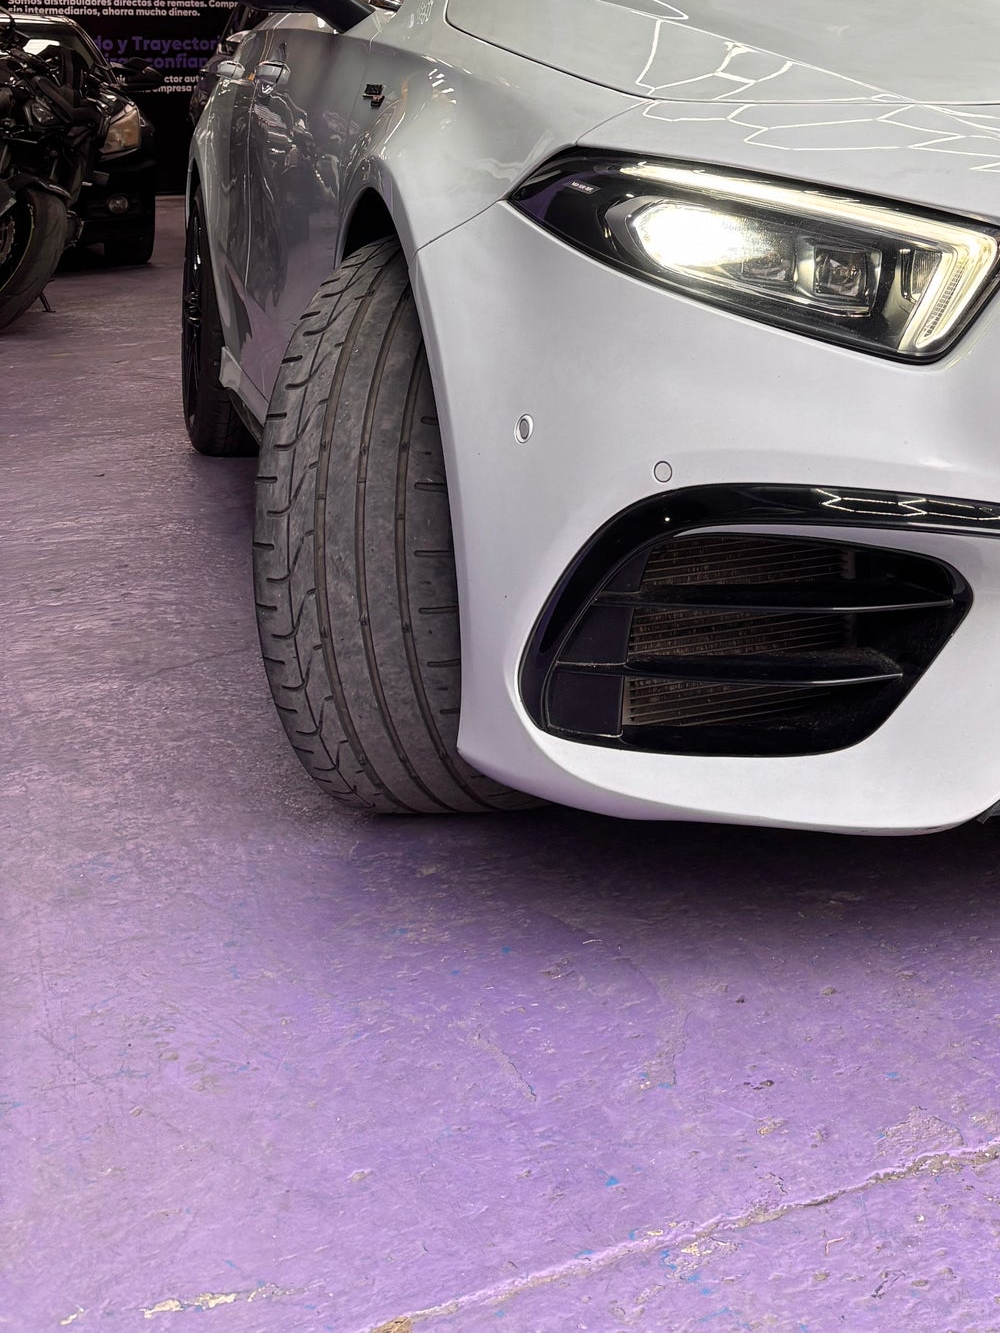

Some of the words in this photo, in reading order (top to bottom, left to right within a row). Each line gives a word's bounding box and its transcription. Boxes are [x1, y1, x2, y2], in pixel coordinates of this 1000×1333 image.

[24, 5, 101, 17] intermediarios,
[101, 7, 135, 16] ahorra
[135, 7, 168, 17] mucho
[168, 7, 201, 17] dinero.
[166, 0, 208, 8] remates.
[208, 0, 239, 10] Compr
[116, 39, 129, 55] y
